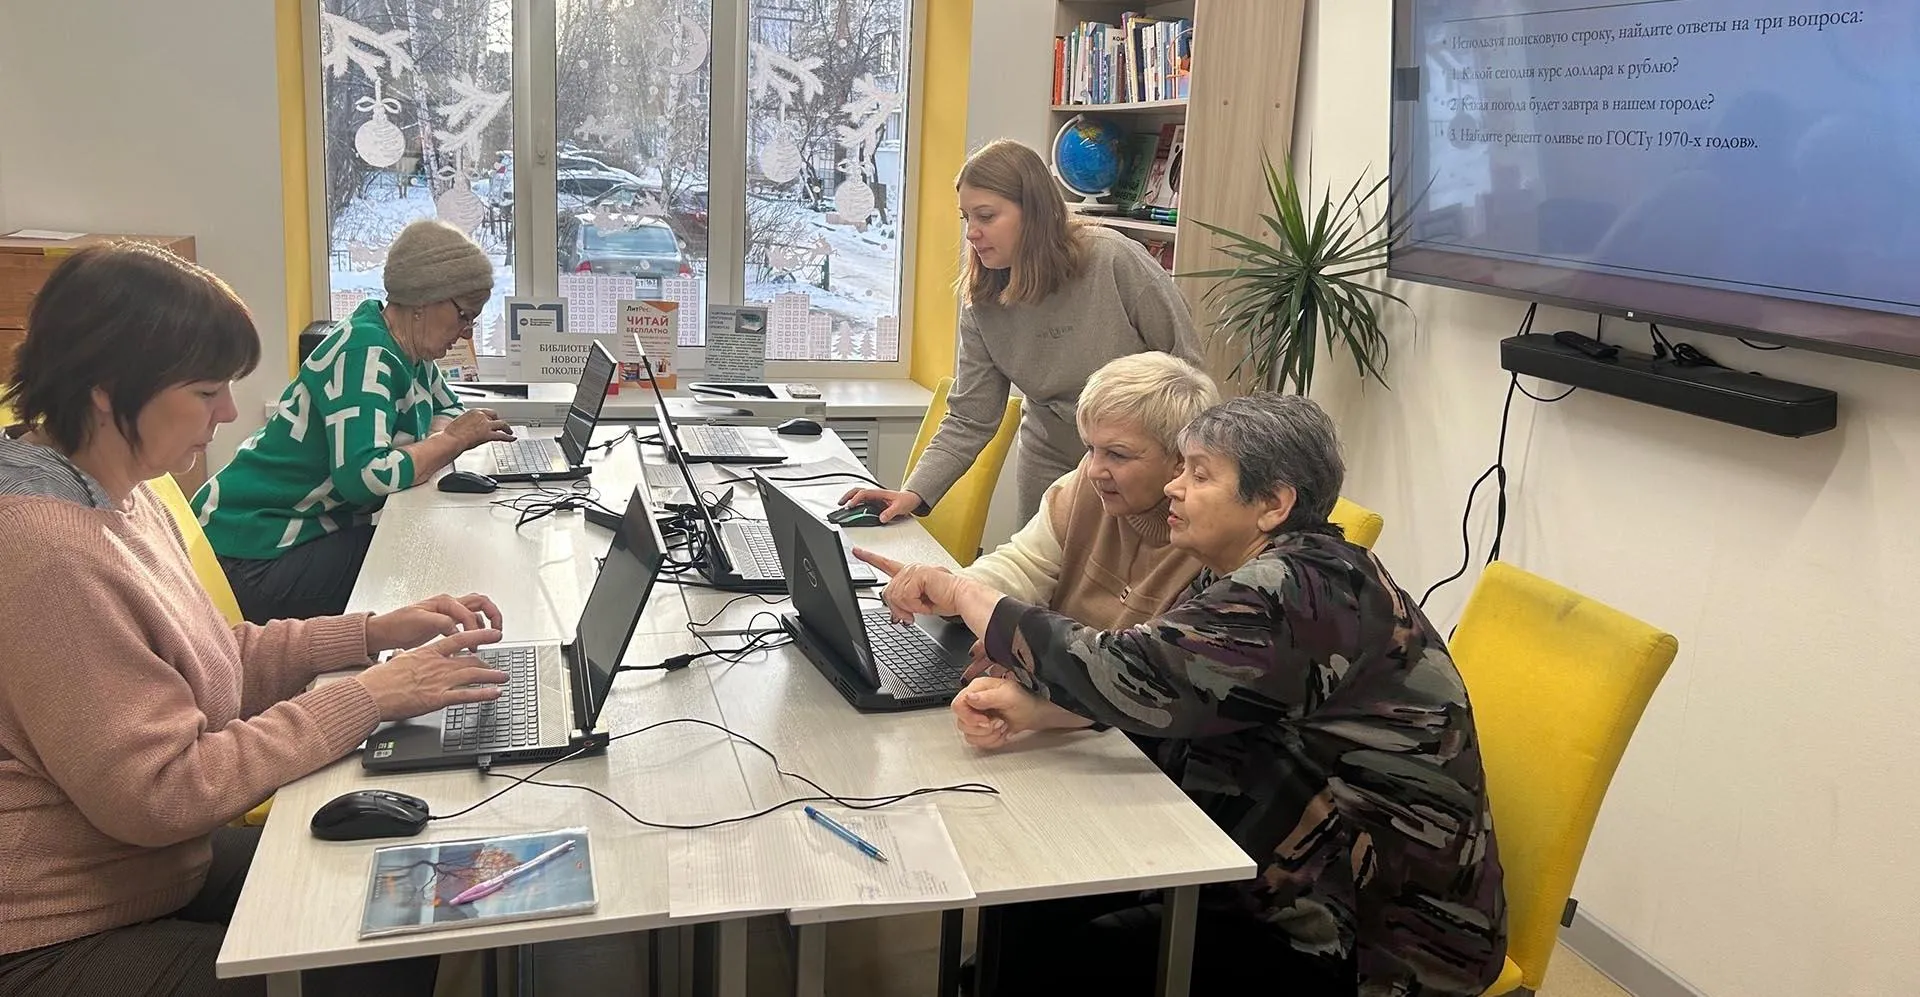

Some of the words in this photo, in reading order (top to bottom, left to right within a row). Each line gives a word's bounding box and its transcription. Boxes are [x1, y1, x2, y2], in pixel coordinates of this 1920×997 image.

[1452, 36, 1504, 50] Используя
[1507, 32, 1568, 48] поисковую
[1571, 28, 1615, 46] строку,
[1618, 22, 1673, 40] найдите
[1677, 19, 1726, 35] ответы
[1732, 18, 1749, 31] на
[1754, 17, 1782, 34] три
[1788, 10, 1864, 31] вопроса:
[1495, 67, 1535, 80] сегодня
[1538, 65, 1562, 82] курс
[1565, 64, 1613, 80] доллара
[1617, 64, 1624, 75] к
[1628, 57, 1680, 80] рублю?
[1491, 102, 1526, 111] погода
[1529, 97, 1560, 115] будет
[1562, 100, 1598, 115] завтра
[1602, 100, 1609, 110] в
[1612, 99, 1656, 110] нашем
[1660, 93, 1715, 115] городе?
[1460, 128, 1502, 142] Найдите
[1504, 132, 1542, 147] рецепт
[1544, 133, 1584, 145] оливье
[1587, 134, 1603, 145] по
[1606, 130, 1653, 151] ГОСТу
[1657, 131, 1702, 147] 1970-х
[1706, 136, 1758, 149] годов».
[626, 315, 669, 326] ЧИТАЙ
[551, 355, 588, 364] НОВОГО
